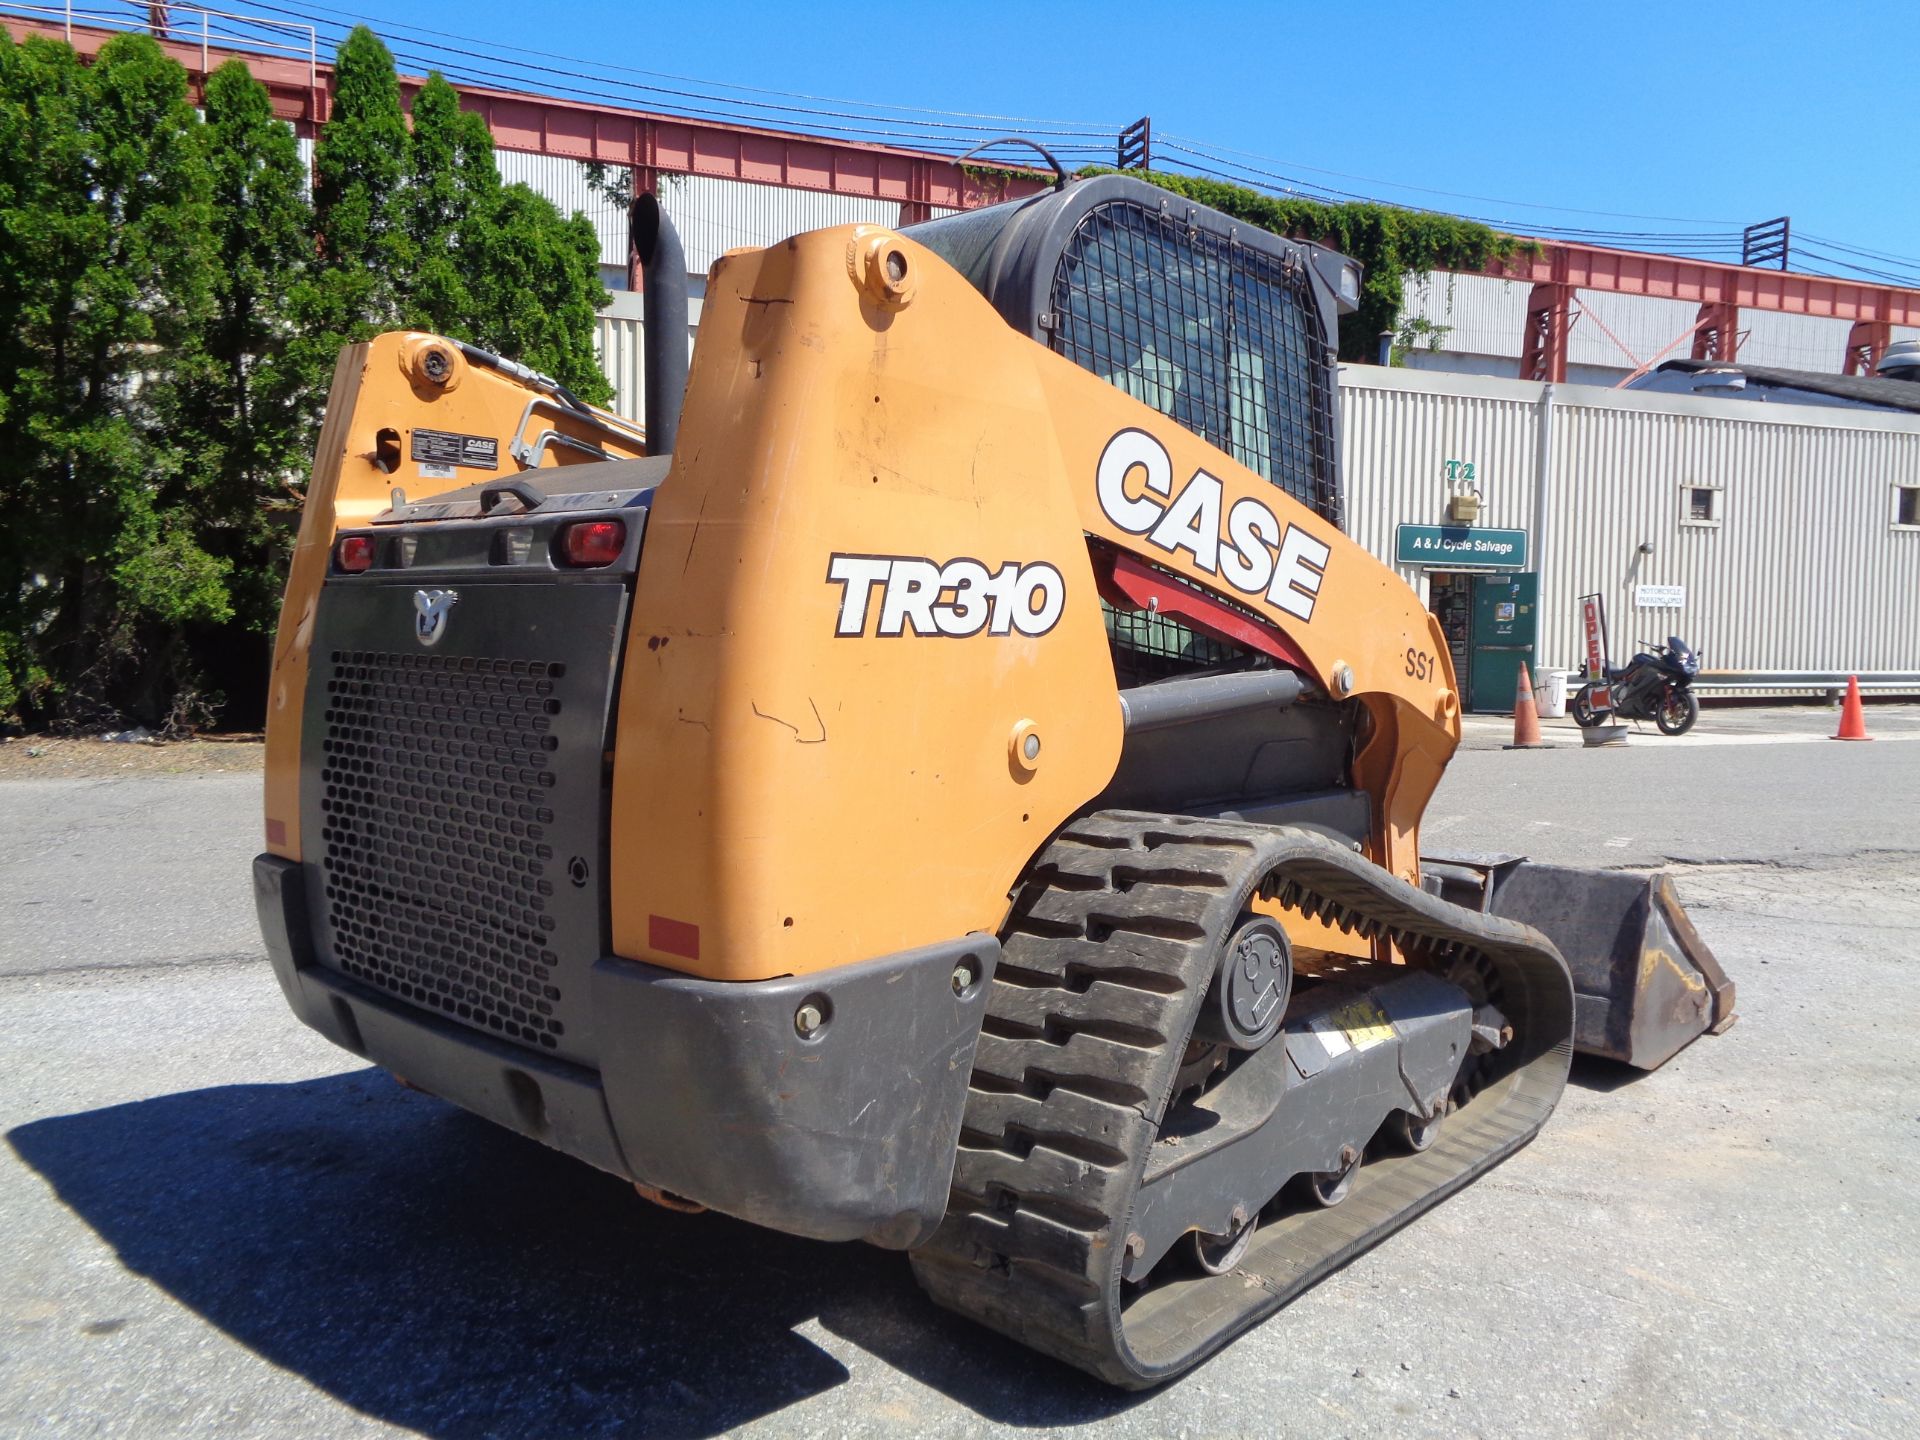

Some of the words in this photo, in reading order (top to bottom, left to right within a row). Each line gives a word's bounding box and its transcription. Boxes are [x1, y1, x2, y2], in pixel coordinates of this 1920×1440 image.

[467, 439, 496, 450] CASE
[1096, 427, 1331, 624] CASE
[1413, 537, 1422, 549] A
[1424, 538, 1432, 549] &
[1434, 538, 1441, 549] J
[1443, 538, 1472, 552] Cycle
[1474, 540, 1513, 554] Salvage
[825, 552, 1066, 638] TR310
[1584, 603, 1600, 672] OPEN
[1405, 647, 1434, 683] SS1
